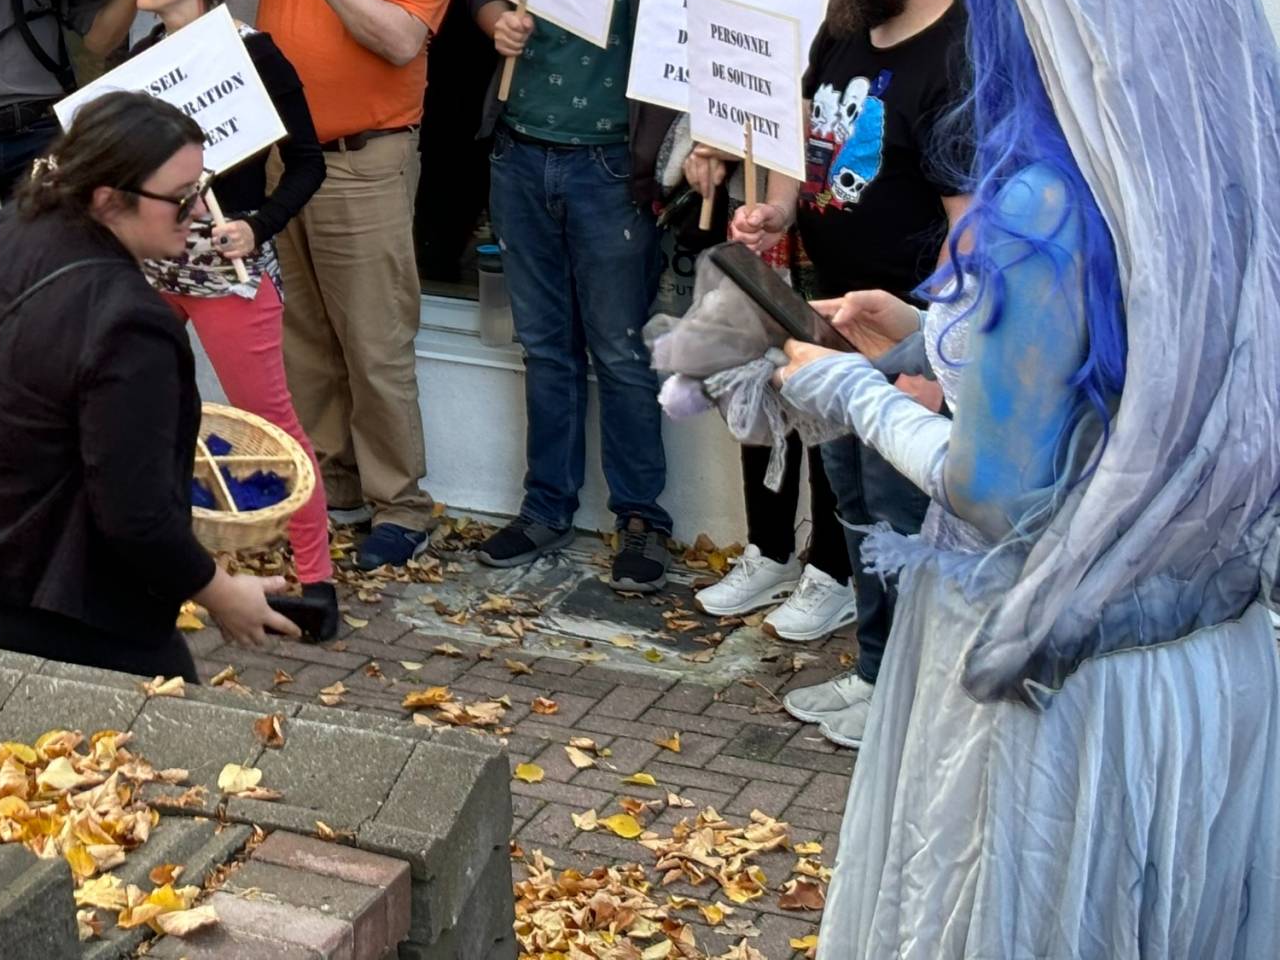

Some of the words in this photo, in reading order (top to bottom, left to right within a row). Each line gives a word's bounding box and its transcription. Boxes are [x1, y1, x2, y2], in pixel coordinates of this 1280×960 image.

[710, 23, 772, 58] PERSONNEL
[712, 61, 726, 81] DE
[727, 67, 772, 97] SOUTIEN
[708, 98, 728, 120] PAS
